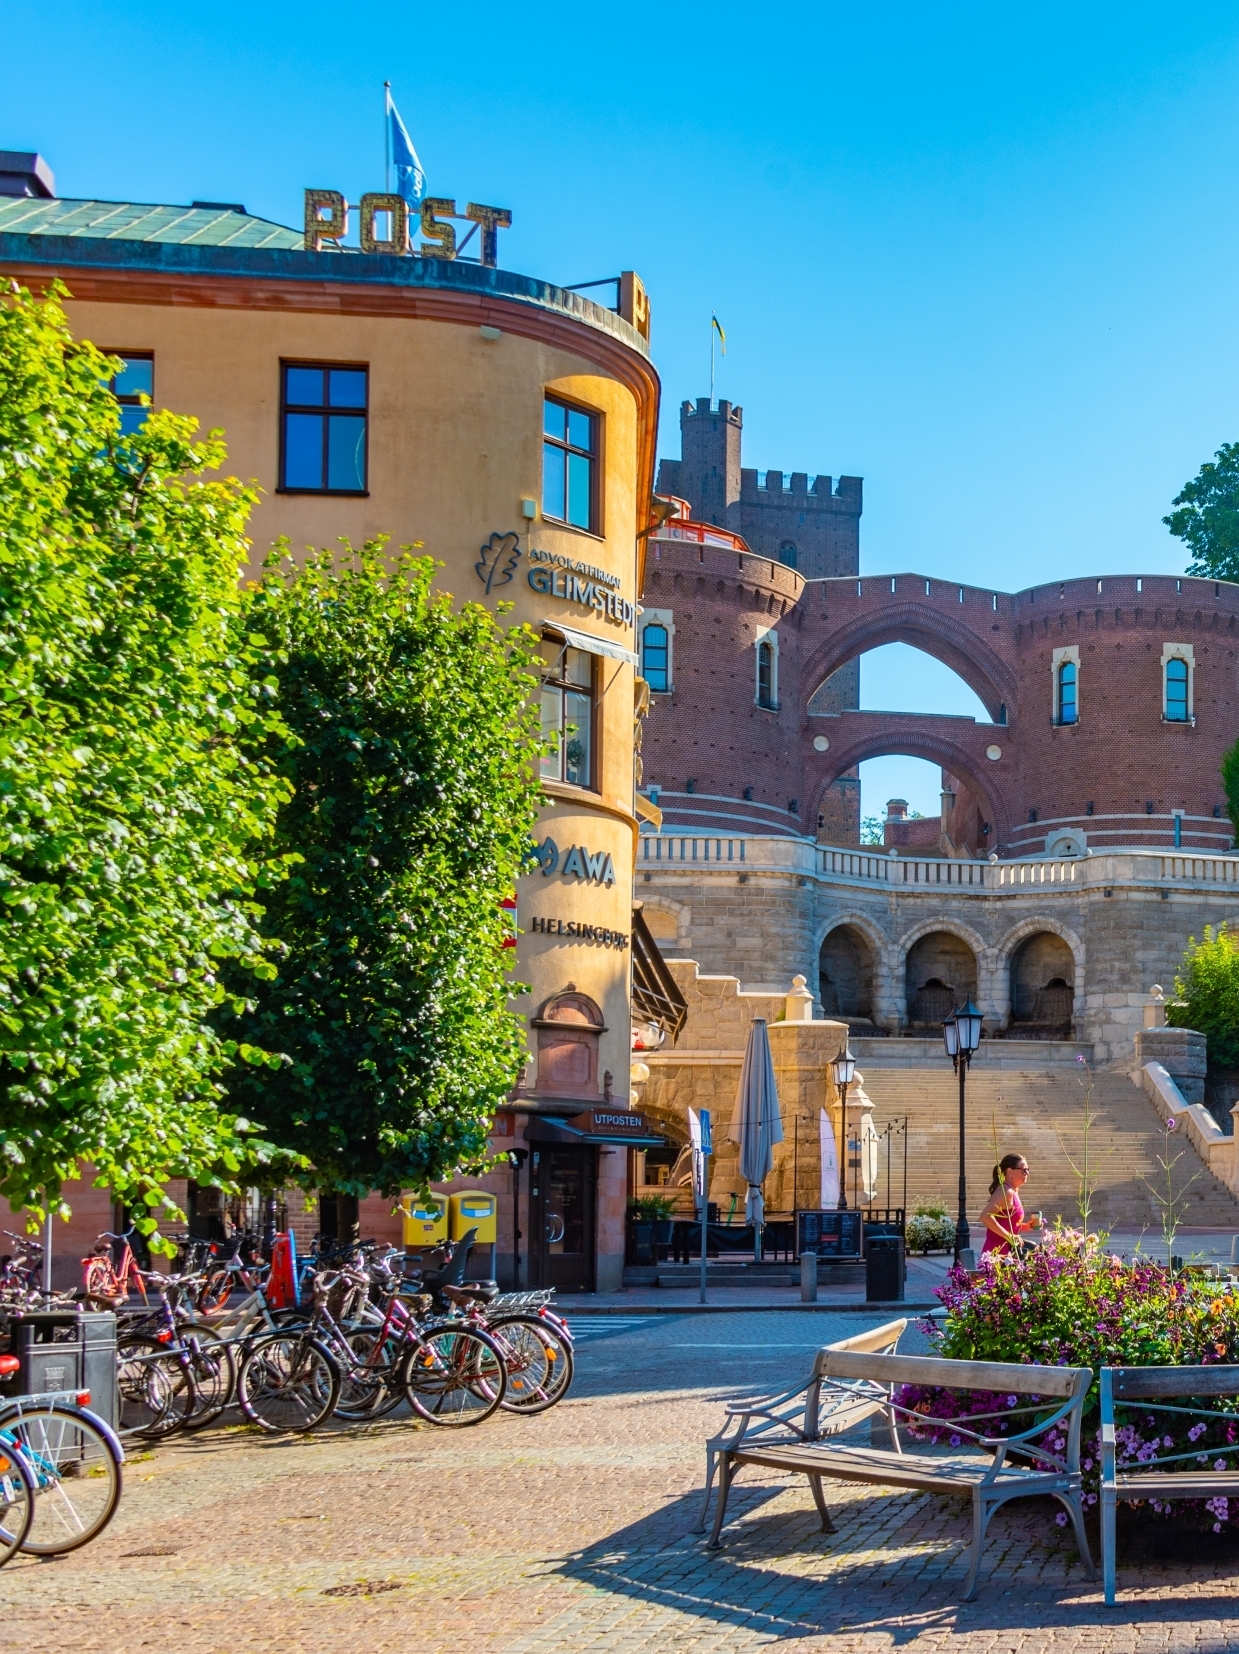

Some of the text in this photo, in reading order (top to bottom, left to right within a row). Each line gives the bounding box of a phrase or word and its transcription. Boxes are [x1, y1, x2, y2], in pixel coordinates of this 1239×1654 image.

[304, 188, 512, 268] POST
[530, 548, 621, 589] ADVOKATFIRMAN
[527, 567, 636, 628] GLIMSTEDT
[562, 844, 616, 885] AWA
[595, 1113, 642, 1127] UTPOSTEN
